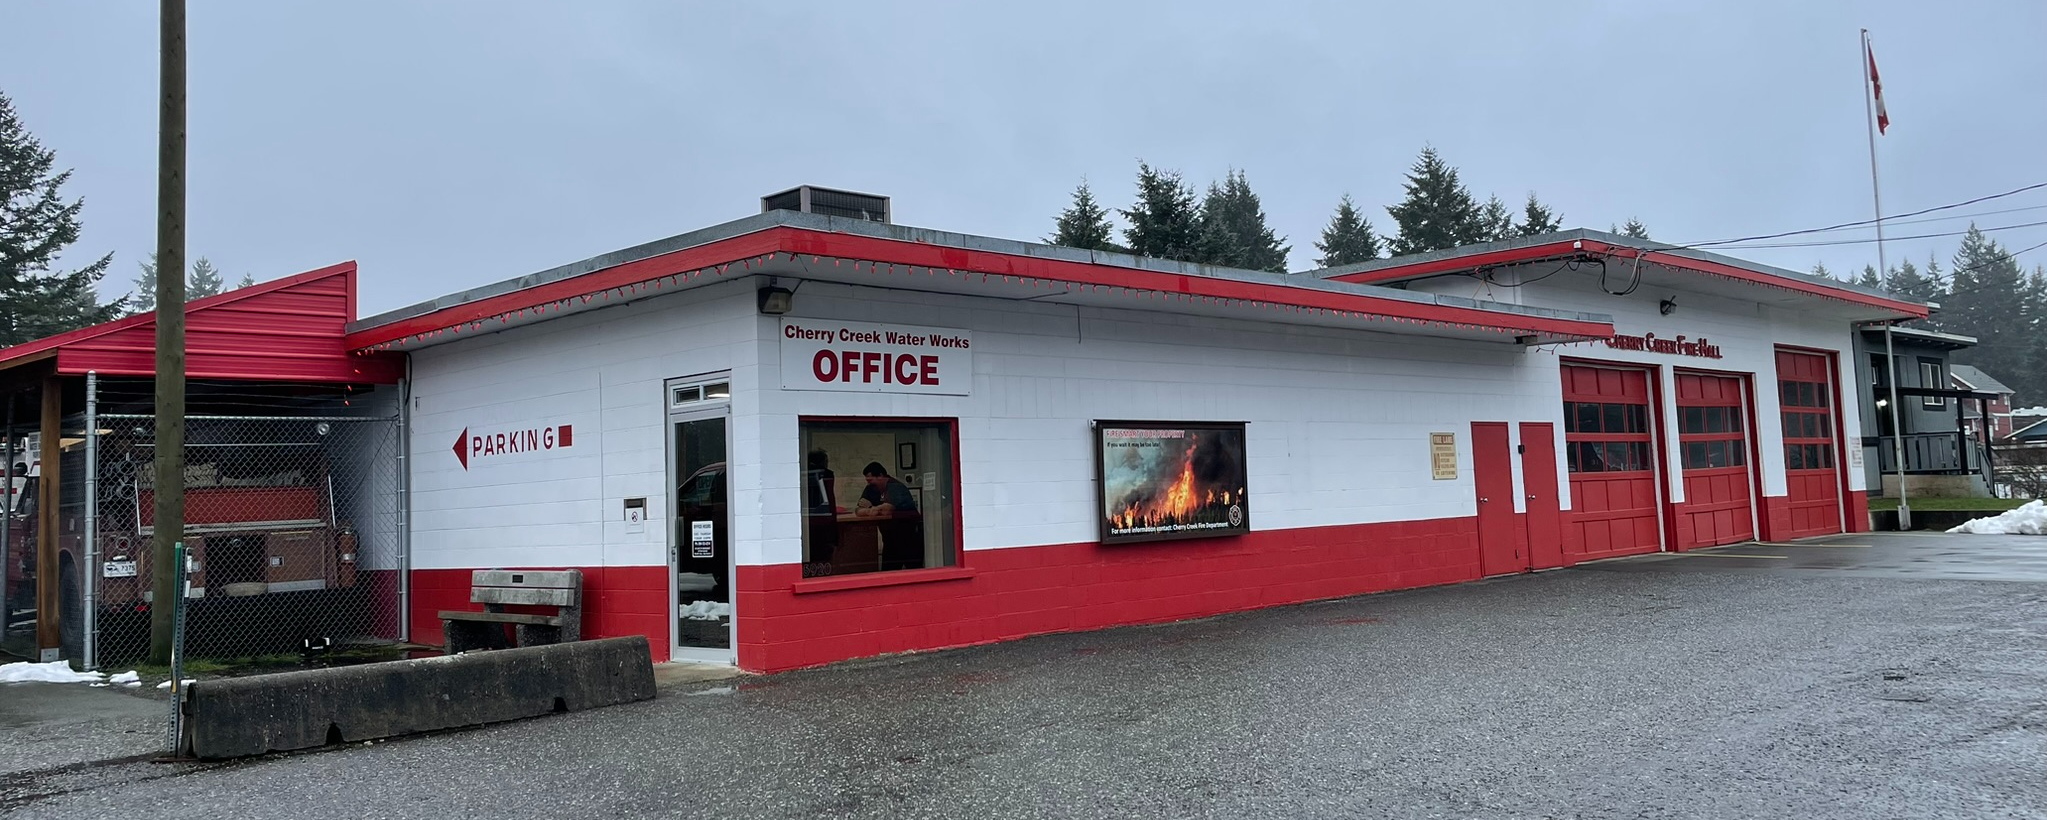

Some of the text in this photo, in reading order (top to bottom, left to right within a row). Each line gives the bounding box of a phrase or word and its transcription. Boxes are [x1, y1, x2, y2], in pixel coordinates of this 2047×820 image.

[784, 325, 970, 349] Cherry Creek Water Works
[1645, 332, 1677, 354] CREEK
[1677, 335, 1698, 356] FIRE
[1698, 338, 1723, 359] HALL
[812, 349, 940, 386] OFFICE
[472, 427, 554, 457] PARKING
[1172, 523, 1186, 531] Cherry
[1186, 522, 1198, 530] Creek
[1205, 521, 1229, 529] Department
[804, 562, 831, 577] 5920
